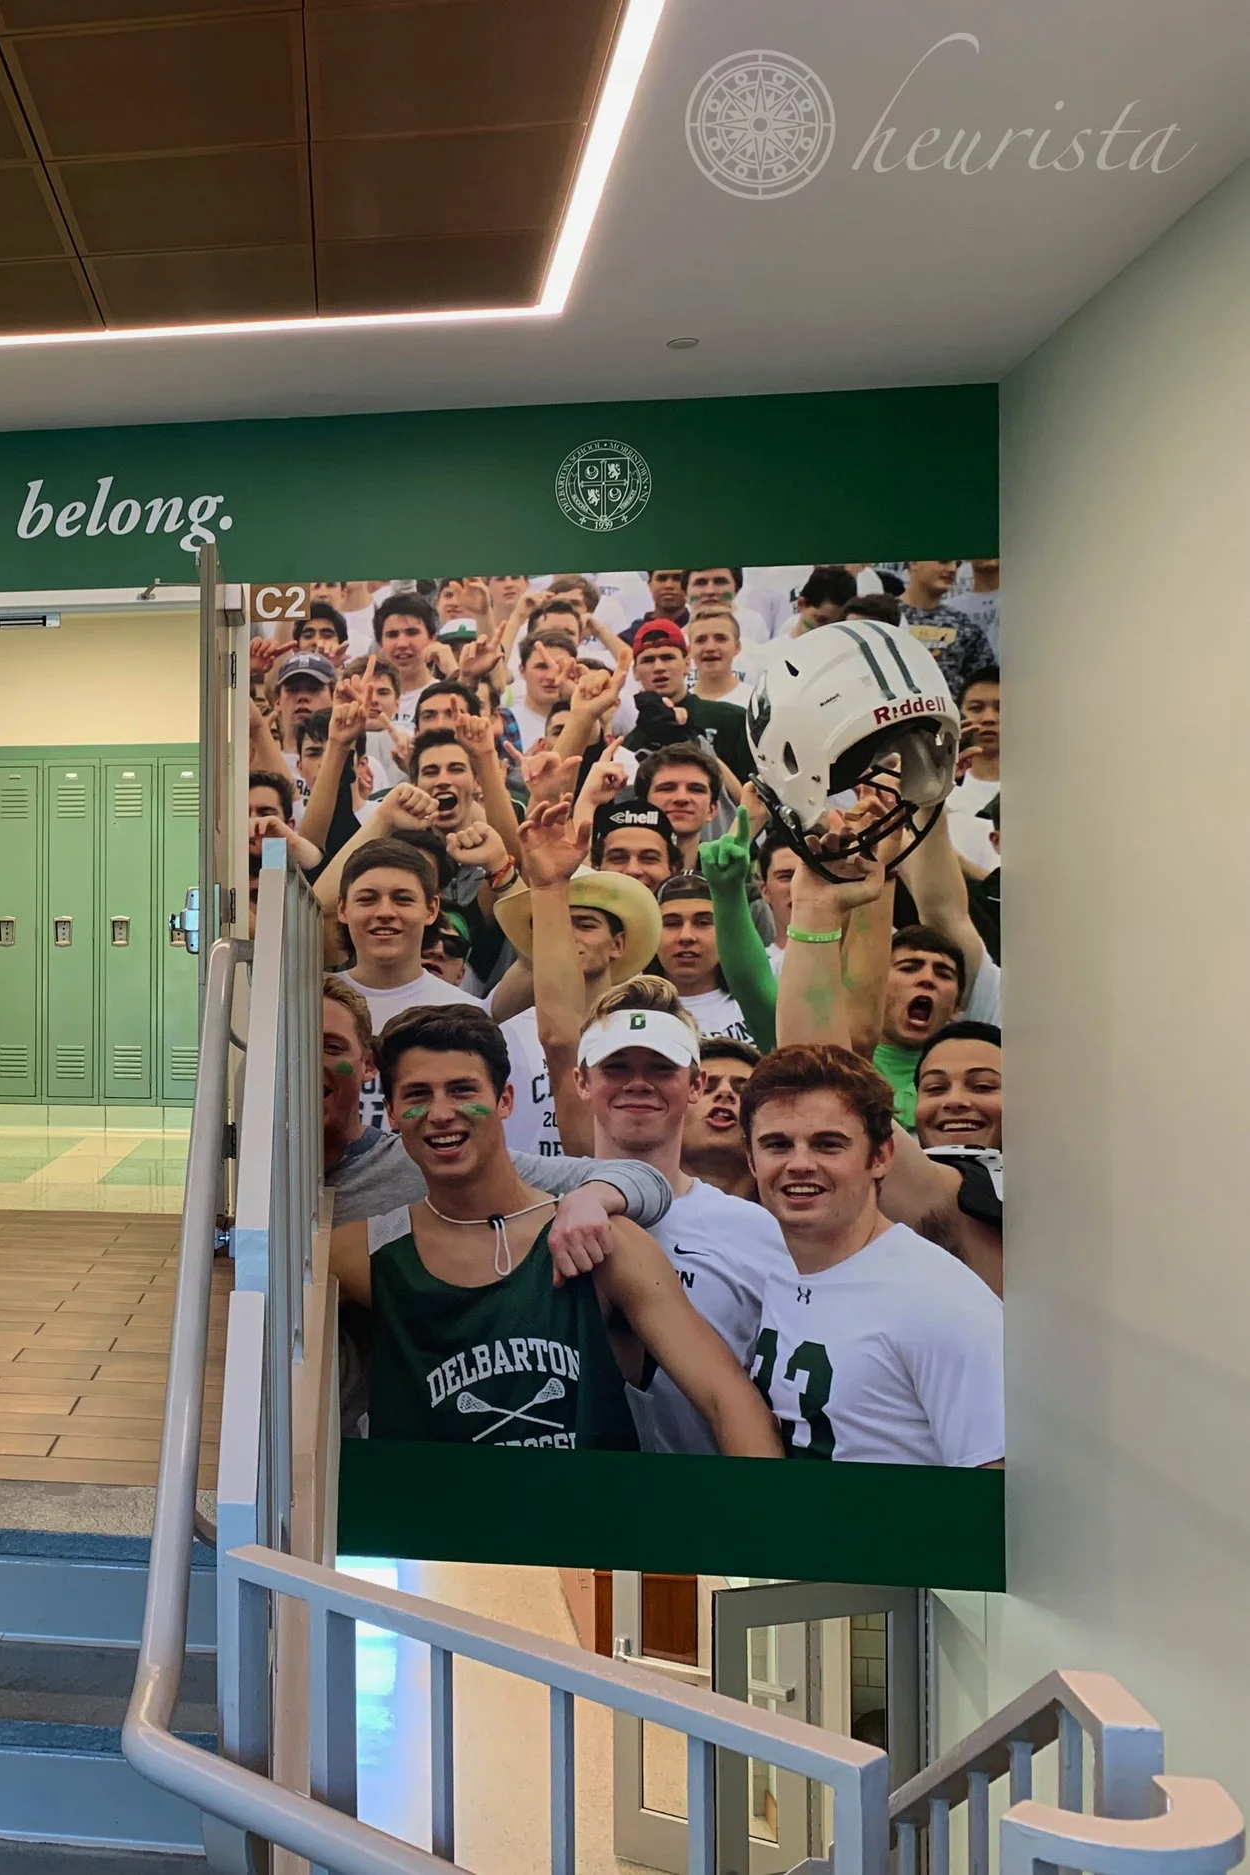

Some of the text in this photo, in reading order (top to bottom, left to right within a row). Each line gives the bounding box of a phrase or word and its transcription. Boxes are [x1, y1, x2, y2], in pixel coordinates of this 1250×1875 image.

[16, 476, 233, 553] belong.
[594, 520, 613, 530] 1939
[255, 586, 306, 619] C2
[873, 696, 947, 726] Riddell
[426, 1337, 580, 1409] DELBARTON
